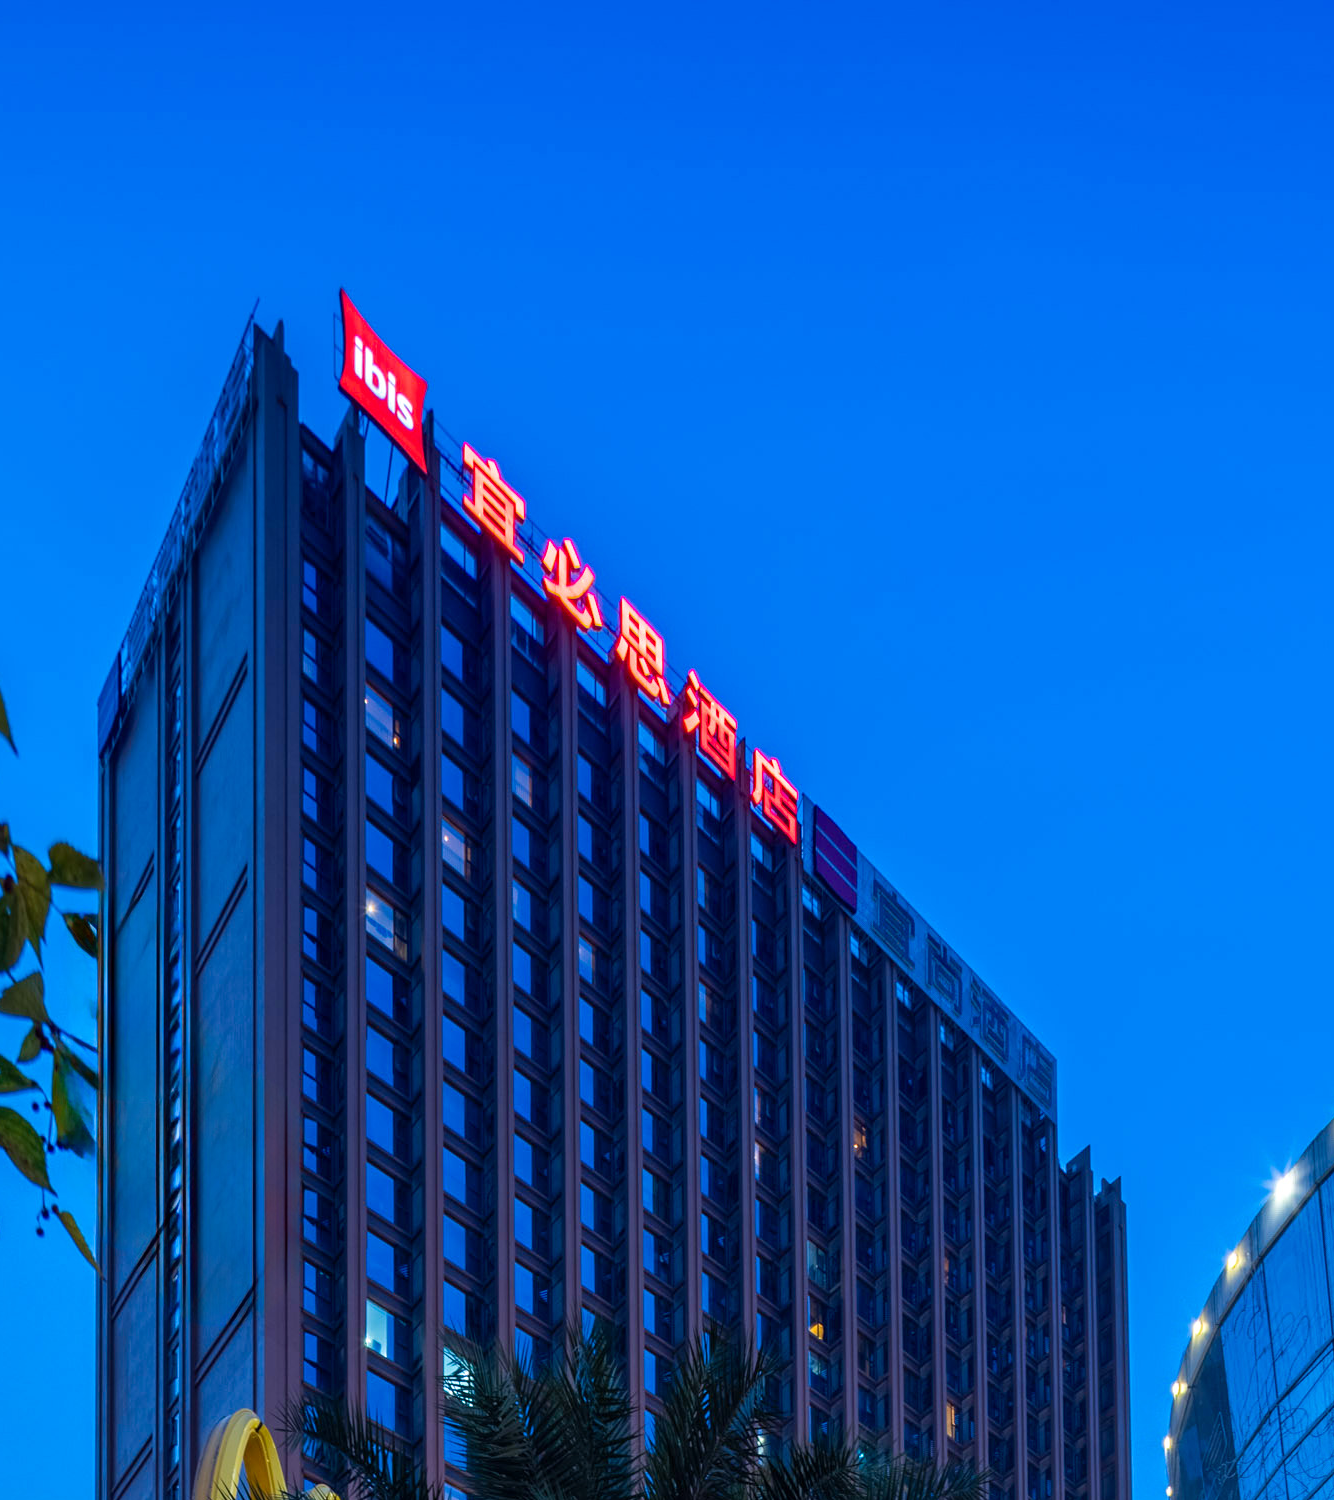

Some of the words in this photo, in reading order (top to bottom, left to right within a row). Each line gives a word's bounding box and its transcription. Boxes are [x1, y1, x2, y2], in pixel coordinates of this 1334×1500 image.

[354, 337, 414, 431] ibis
[462, 441, 799, 845] 宜必思酒店
